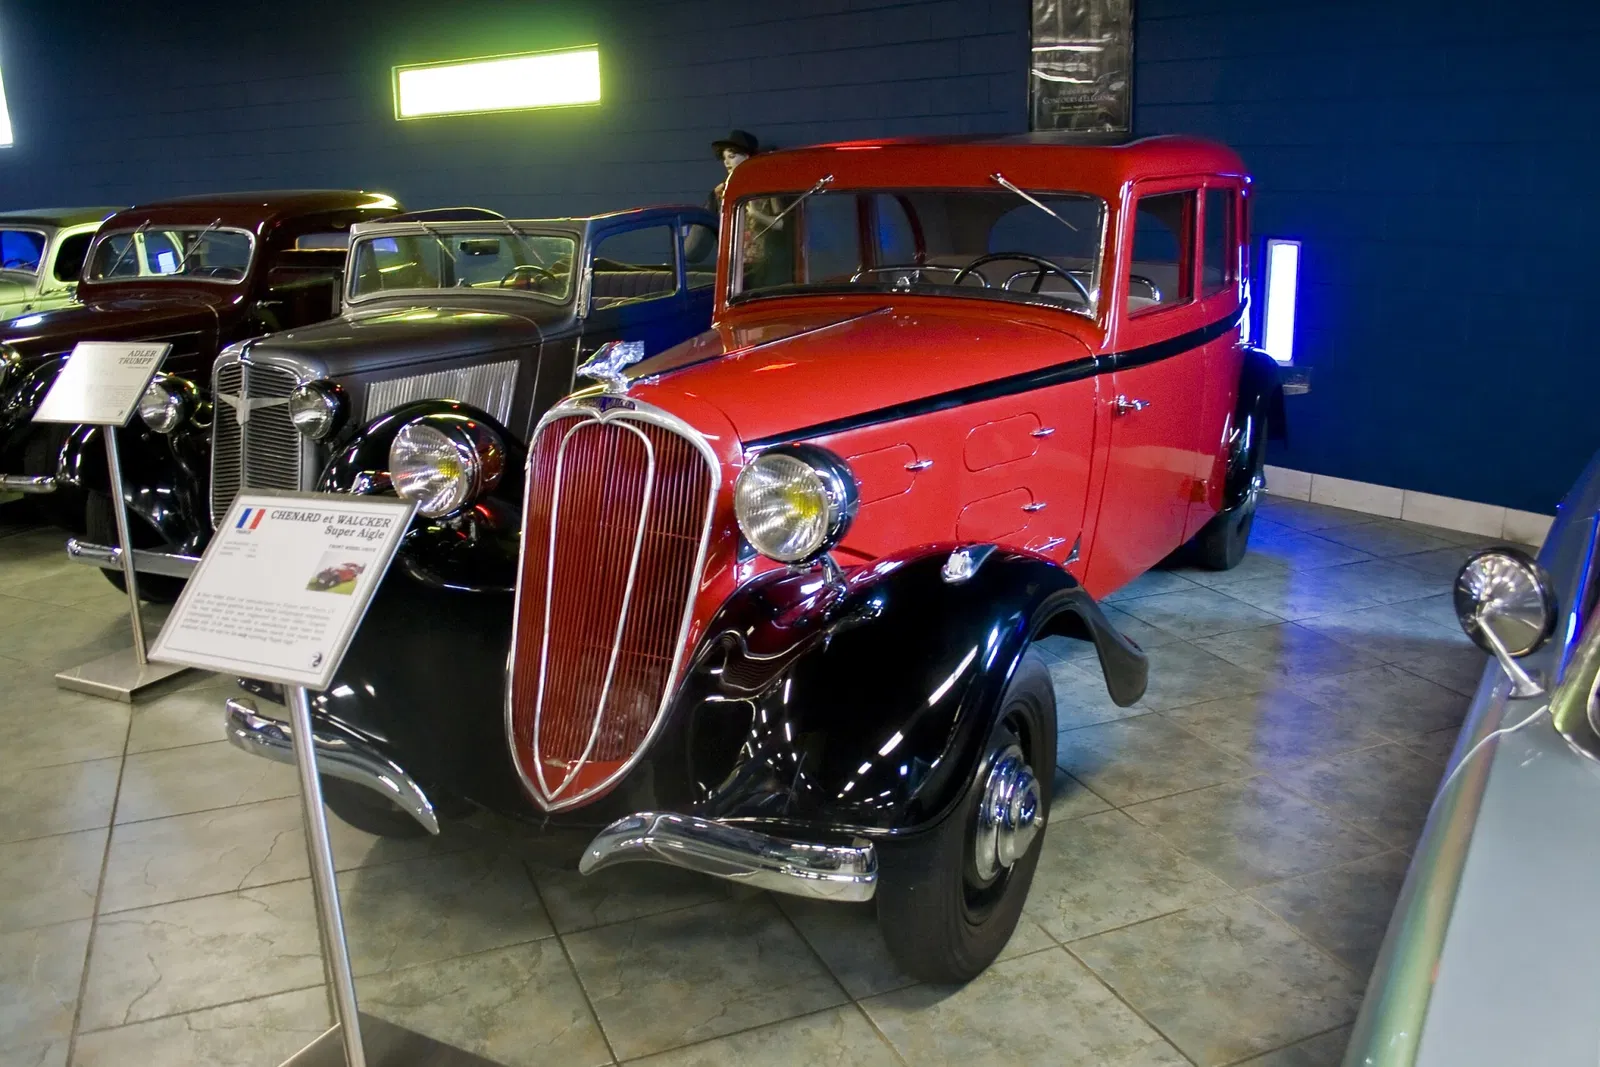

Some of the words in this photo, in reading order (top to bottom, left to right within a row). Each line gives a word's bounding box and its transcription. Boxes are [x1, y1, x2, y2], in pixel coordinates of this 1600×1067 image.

[127, 349, 158, 357] ADLER
[118, 357, 153, 365] TRUMPF
[270, 510, 322, 523] CHENARD
[322, 514, 335, 524] et
[336, 515, 392, 528] WALCKER
[324, 526, 356, 539] Super
[356, 529, 385, 541] Aigle
